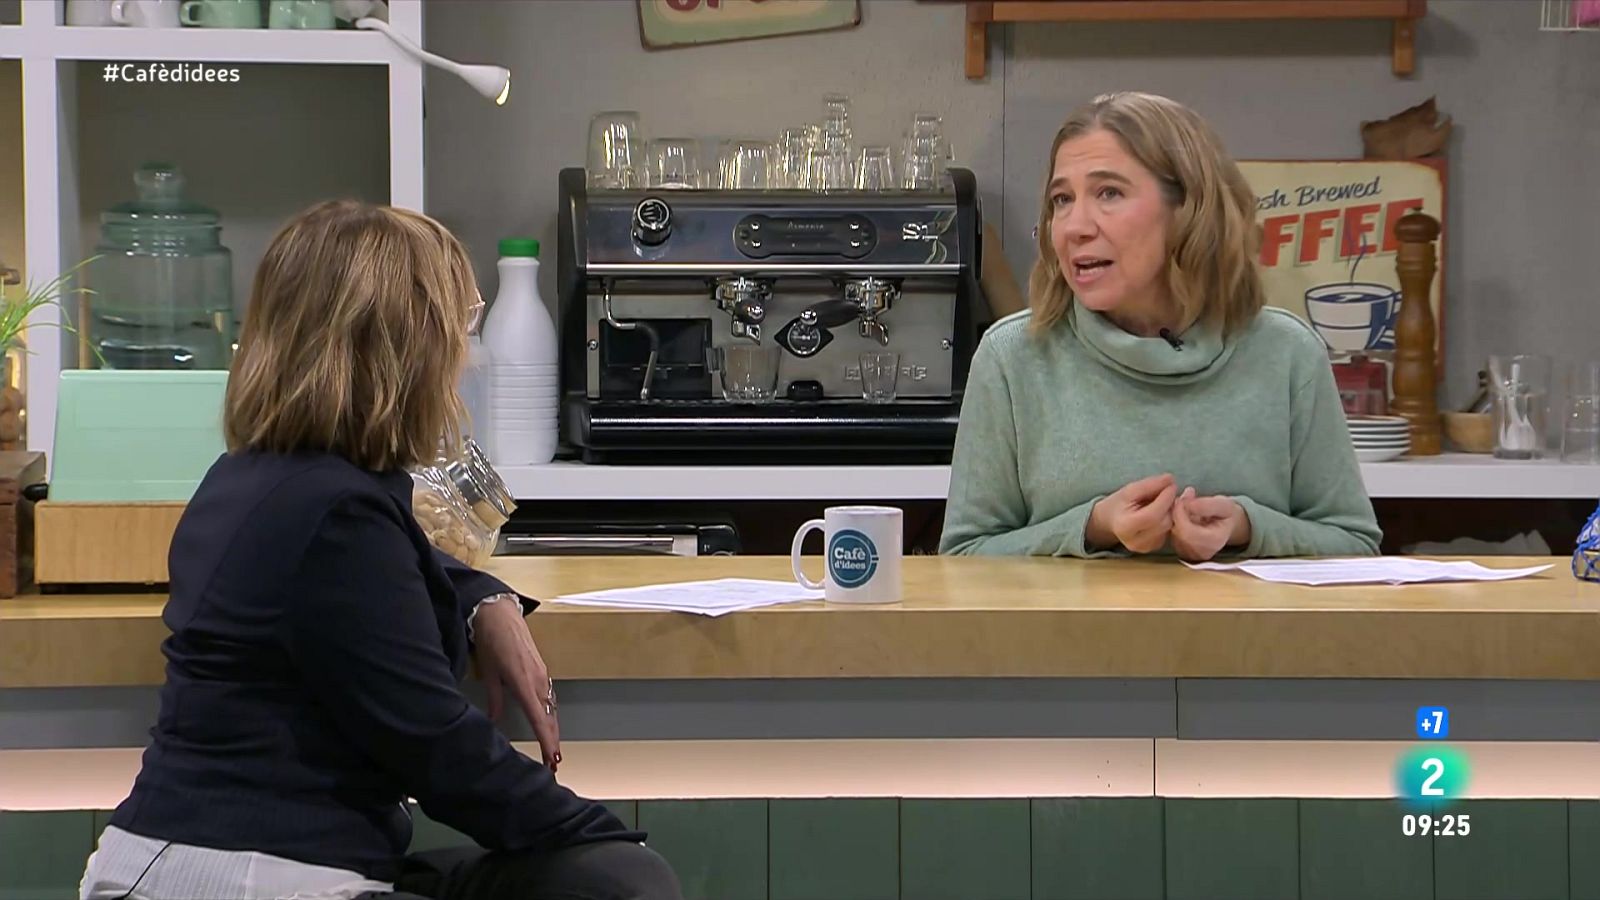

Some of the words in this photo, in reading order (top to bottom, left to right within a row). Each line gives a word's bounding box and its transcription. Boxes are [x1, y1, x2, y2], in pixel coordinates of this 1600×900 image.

[1294, 175, 1382, 207] Brewed
[834, 546, 866, 561] Cafè
[834, 560, 866, 570] d'idees
